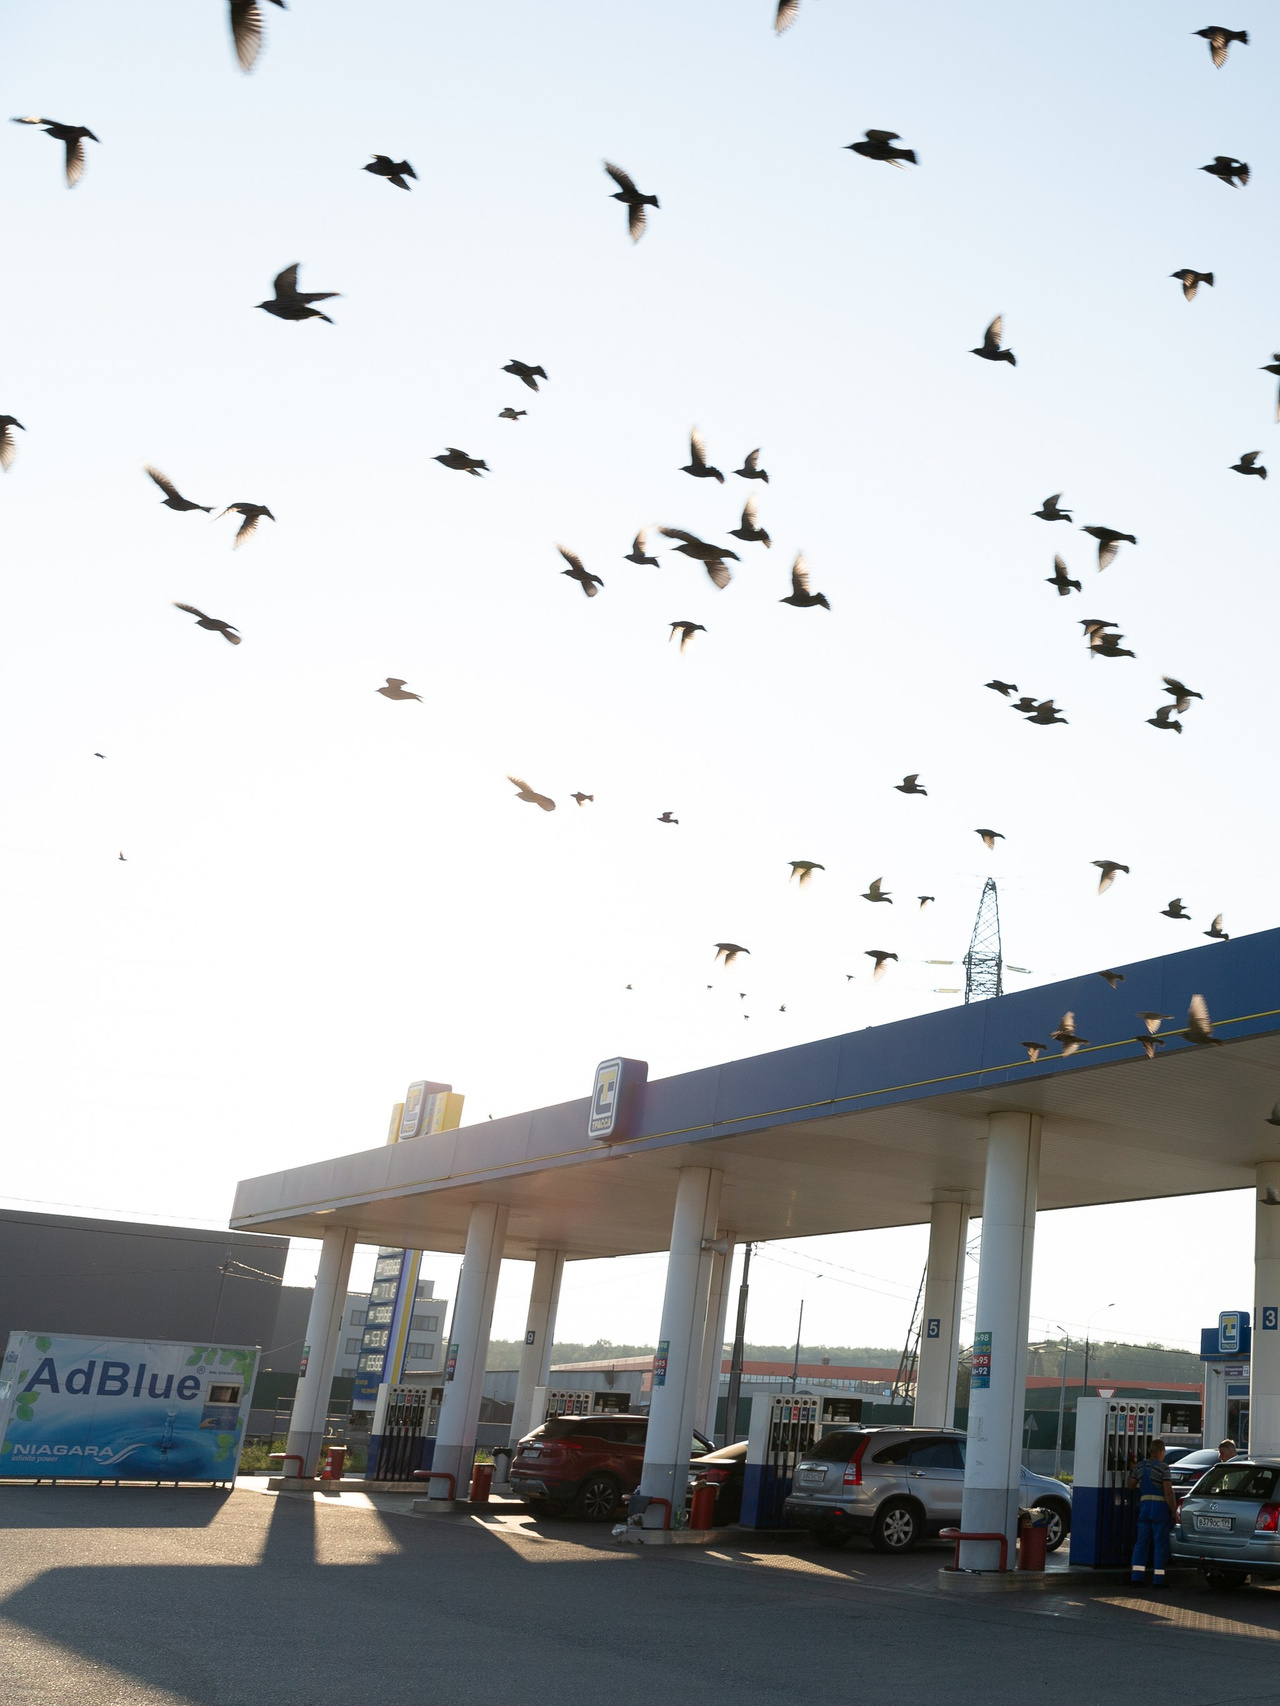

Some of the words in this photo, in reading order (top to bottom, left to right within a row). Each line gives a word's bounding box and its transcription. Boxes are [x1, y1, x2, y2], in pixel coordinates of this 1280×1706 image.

[591, 1118, 611, 1131] ТРАССА
[1266, 1310, 1276, 1327] 3
[929, 1321, 938, 1336] 5
[527, 1332, 534, 1343] 9
[13, 1444, 114, 1457] NIAGARA
